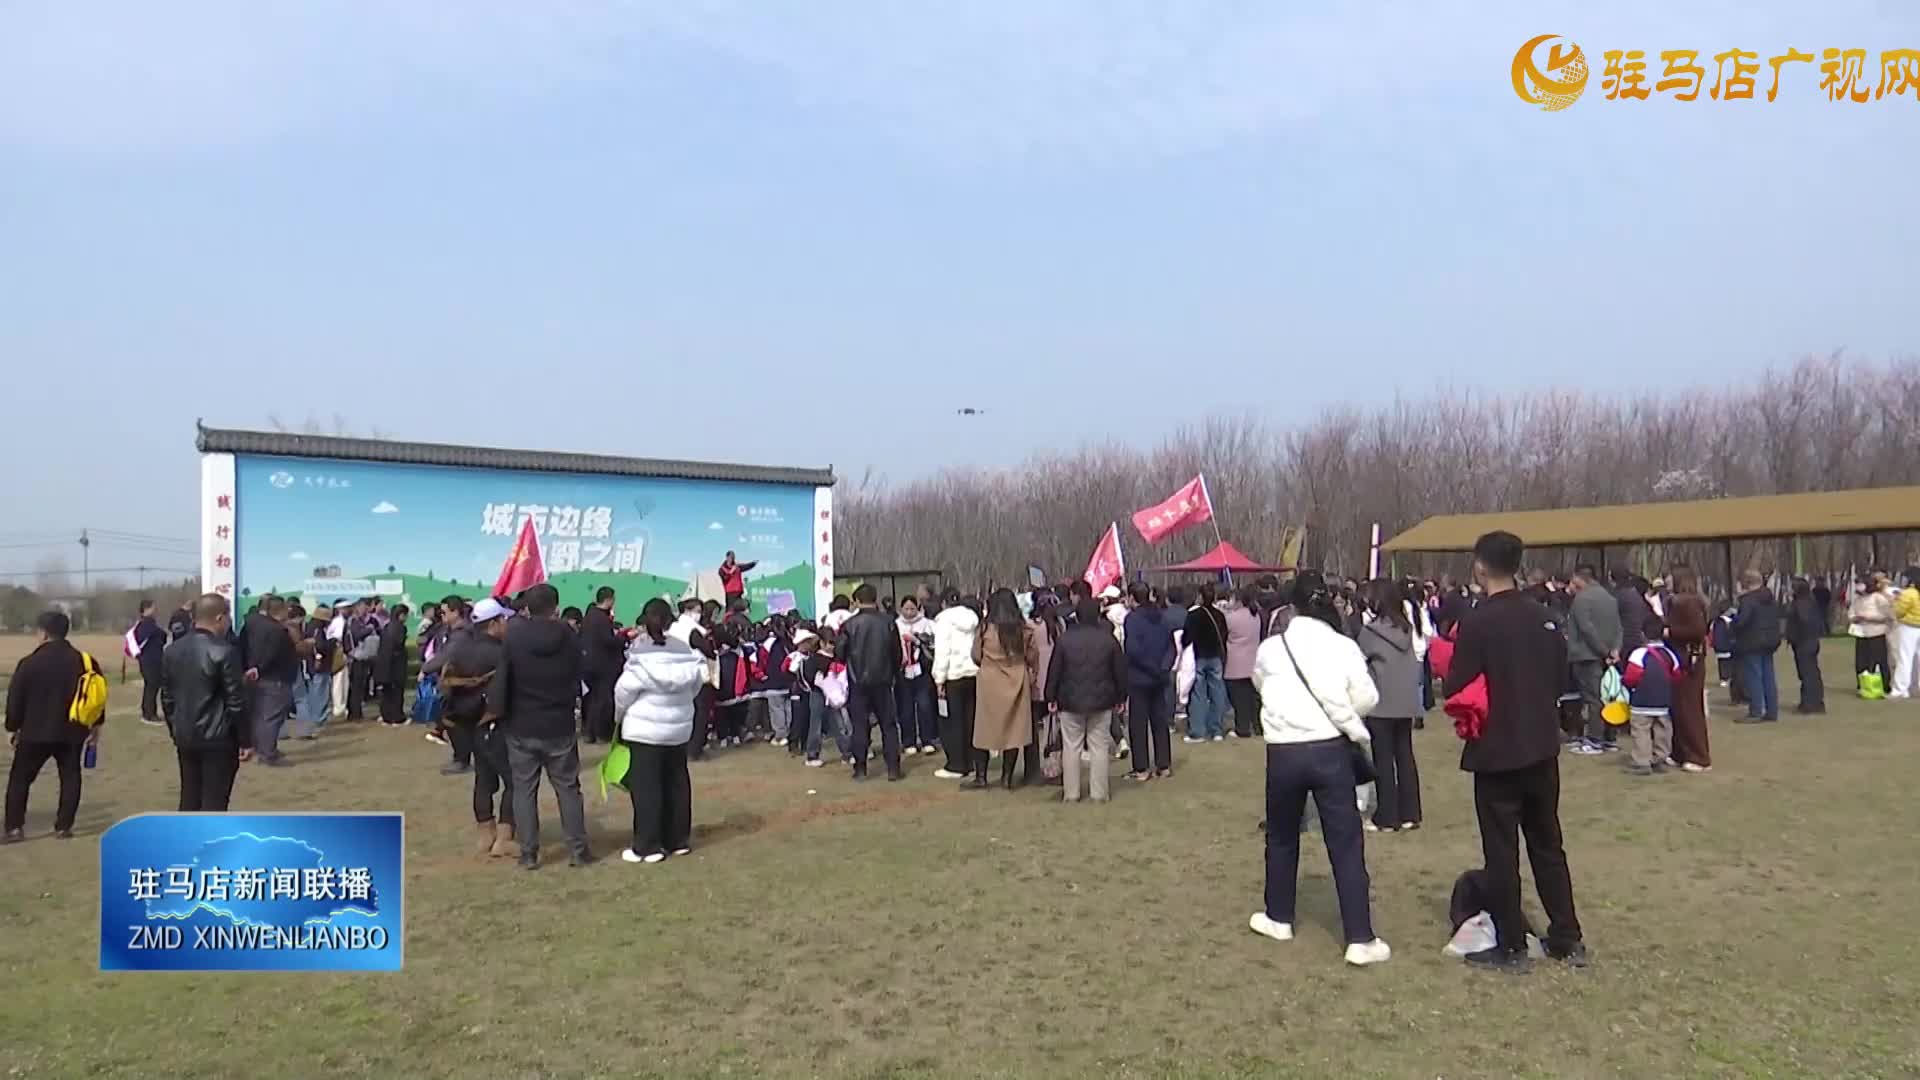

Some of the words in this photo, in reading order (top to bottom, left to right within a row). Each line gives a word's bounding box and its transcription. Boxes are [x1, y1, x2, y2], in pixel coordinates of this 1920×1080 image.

[480, 503, 613, 537] 城市边缘
[543, 537, 644, 573] 野之间
